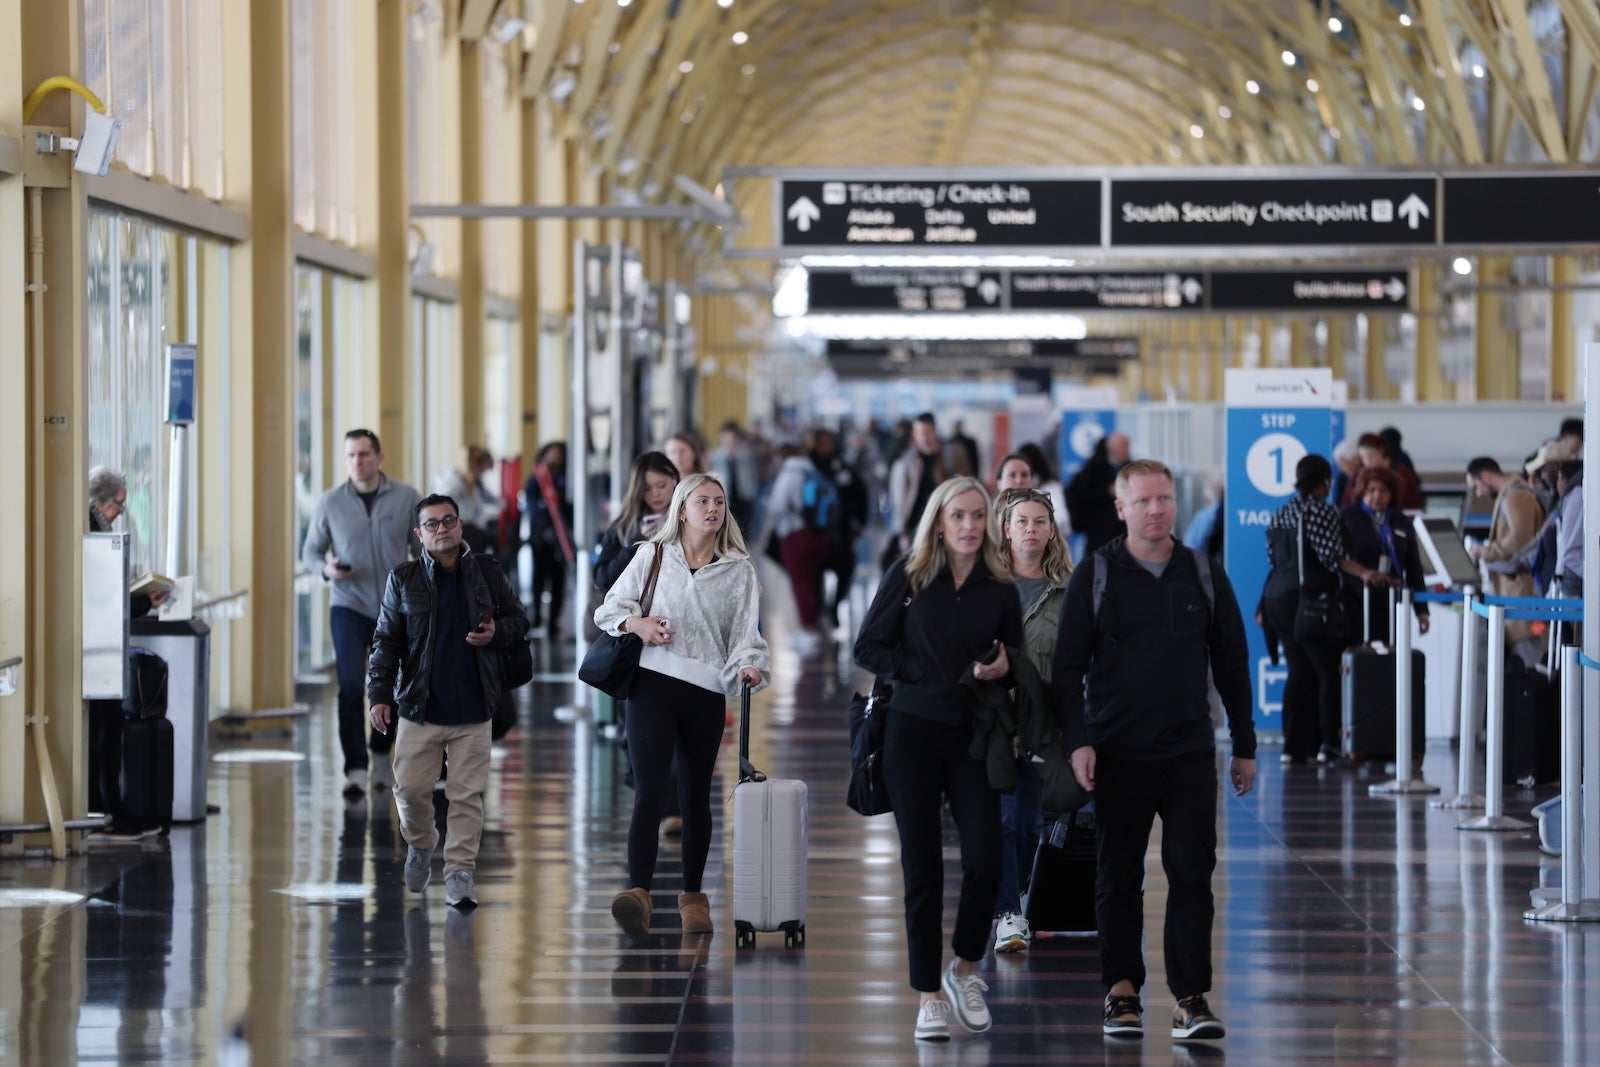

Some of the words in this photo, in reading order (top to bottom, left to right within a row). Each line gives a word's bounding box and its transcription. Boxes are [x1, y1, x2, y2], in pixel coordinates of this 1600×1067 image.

[847, 184, 934, 206] Ticketing
[948, 184, 1030, 204] Check-In
[847, 209, 895, 225] Alaska
[925, 209, 964, 225] Delta
[988, 209, 1036, 225] United
[1122, 202, 1179, 222] South
[1181, 201, 1258, 226] Security
[1260, 199, 1368, 225] Checkpoint
[847, 227, 914, 242] American
[1256, 382, 1303, 393] American
[1260, 414, 1296, 428] STEP
[1268, 446, 1283, 484] 1
[1237, 509, 1272, 526] TAG
